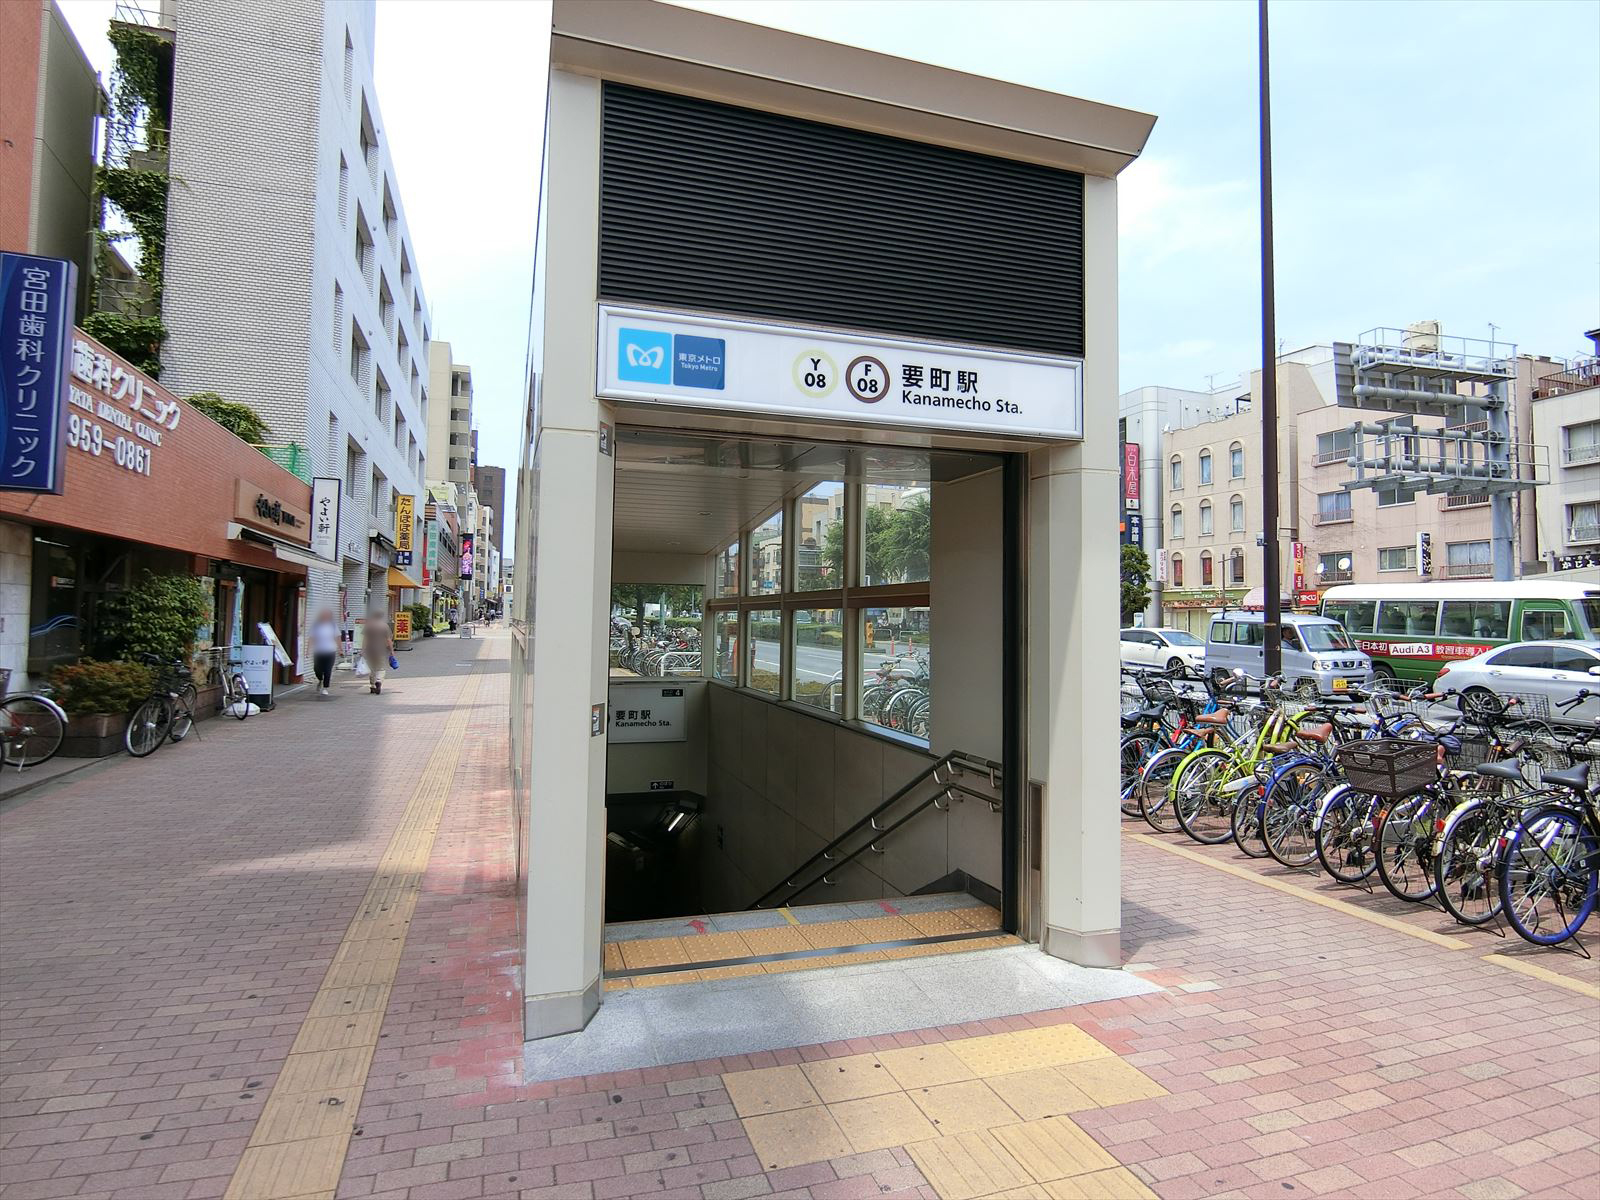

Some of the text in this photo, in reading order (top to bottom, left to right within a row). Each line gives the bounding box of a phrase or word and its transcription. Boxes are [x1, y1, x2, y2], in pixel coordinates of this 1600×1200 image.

[678, 352, 721, 365] 東京メトロ
[810, 358, 821, 371] Y
[12, 267, 50, 478] 宮田歯科クリニック
[681, 362, 699, 371] Tokyo
[864, 364, 872, 376] F
[71, 339, 181, 431] 歯科クリニック
[804, 373, 826, 388] 08
[857, 378, 878, 393] 08
[902, 364, 979, 394] 要町駅
[902, 390, 1023, 414] Kanamecho Sta.
[318, 497, 331, 534] やよい軒
[398, 497, 412, 550] たんぽぽ薬局
[1362, 641, 1388, 650] 日本初
[1391, 645, 1431, 654] Audi A3
[615, 709, 651, 720] 要町駅
[615, 720, 657, 728] Kanamecho
